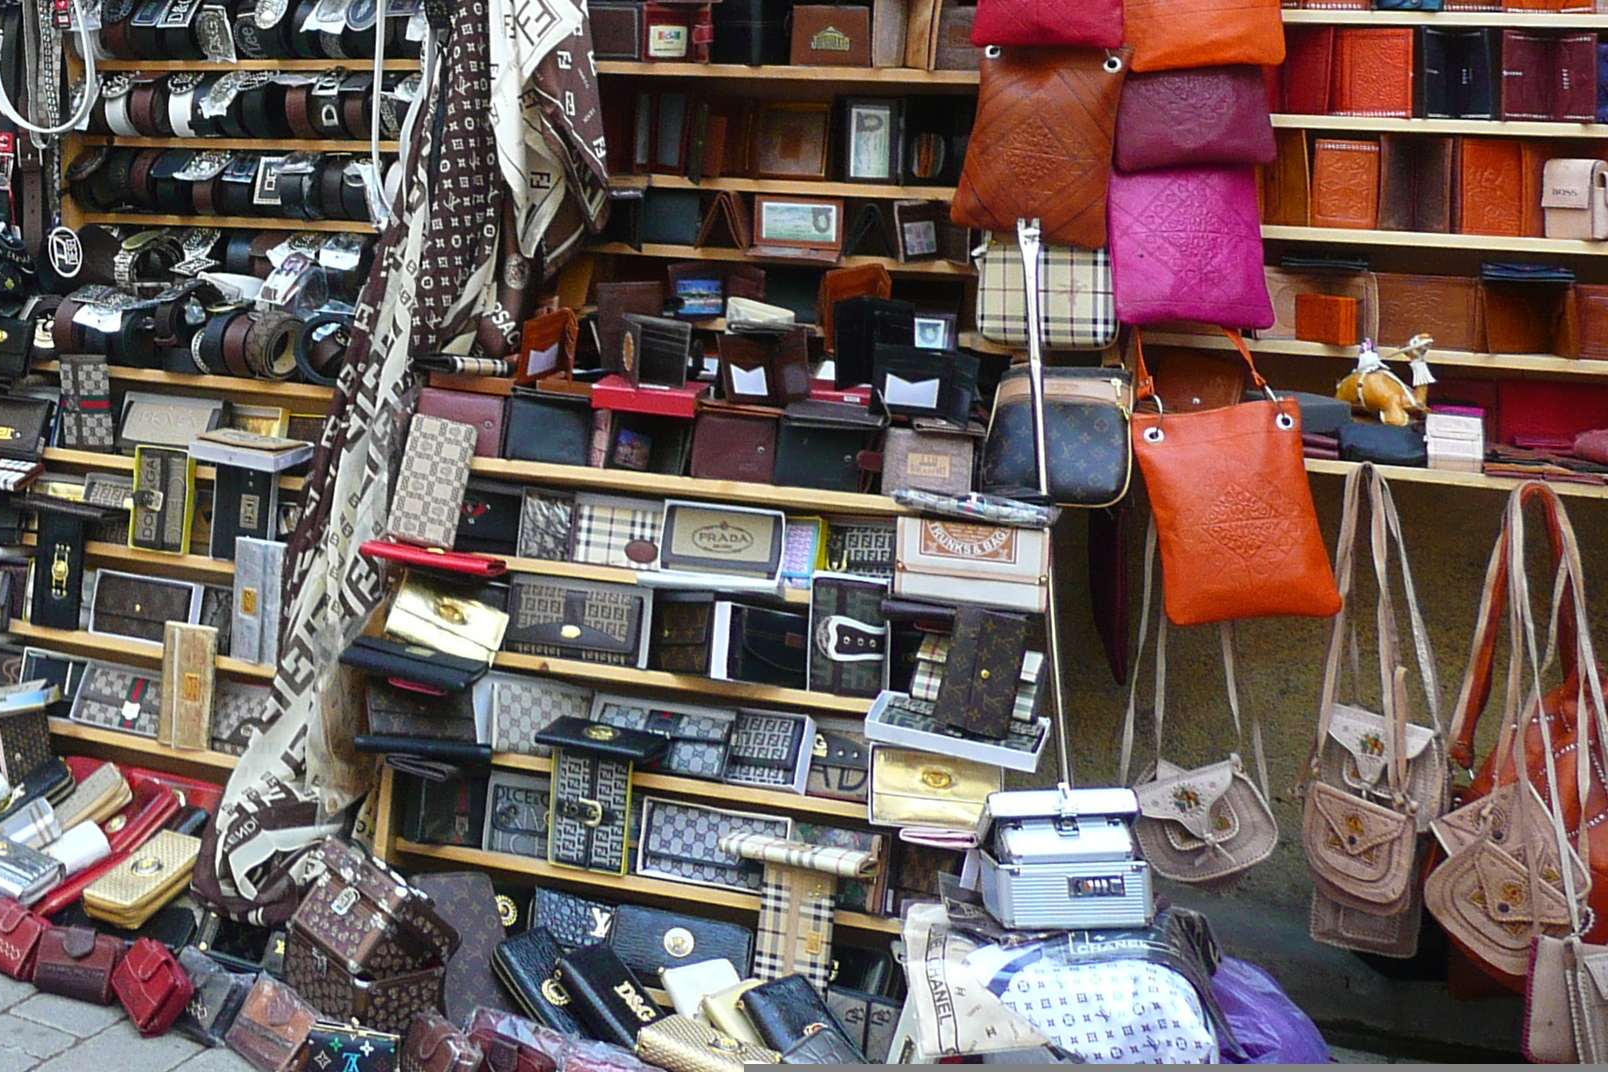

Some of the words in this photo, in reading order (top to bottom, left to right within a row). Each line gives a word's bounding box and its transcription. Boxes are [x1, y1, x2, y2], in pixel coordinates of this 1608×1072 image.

[242, 26, 262, 52] Lee
[698, 531, 750, 544] PRADA
[930, 522, 971, 555] TRUNKS
[973, 544, 983, 555] &
[1076, 938, 1149, 955] CHANEL
[614, 981, 656, 1022] D&G
[929, 957, 953, 1026] CHANEL
